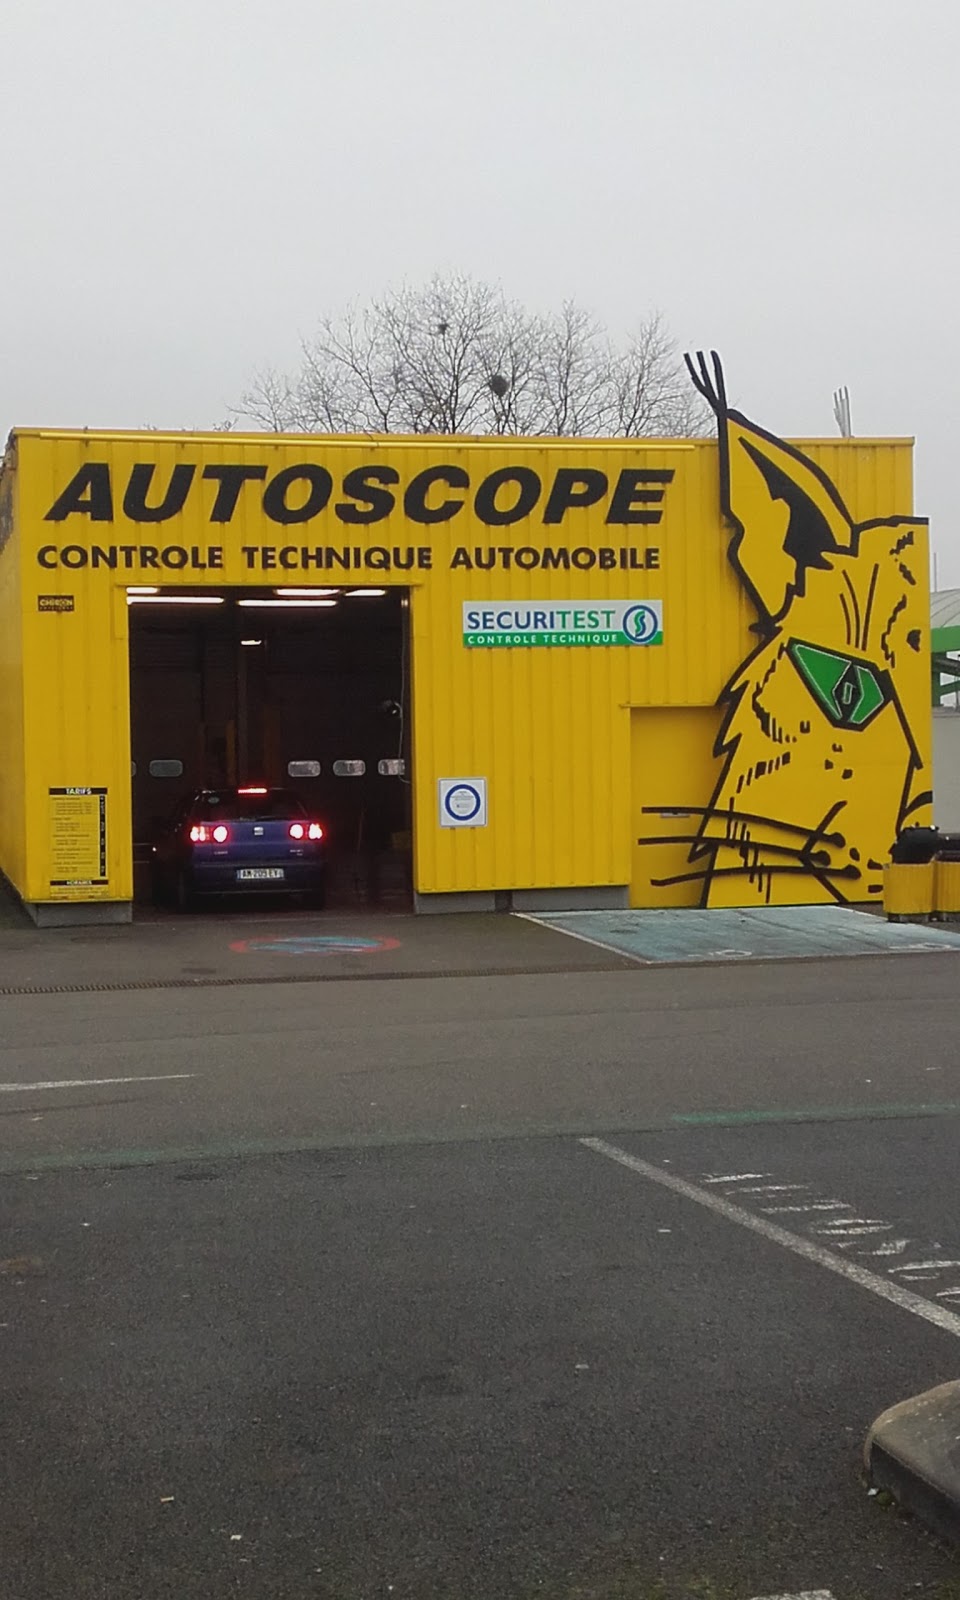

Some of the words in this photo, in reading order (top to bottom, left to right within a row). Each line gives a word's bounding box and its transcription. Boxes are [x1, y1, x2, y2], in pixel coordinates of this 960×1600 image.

[43, 462, 675, 526] AUTOSCOPE
[37, 545, 223, 569] CONTROLE
[242, 546, 433, 570] TECHNIQUE
[450, 546, 660, 570] AUTOMOBILE
[467, 610, 616, 630] SECURITEST
[467, 634, 537, 645] CONTROLE
[543, 633, 618, 644] TECHNIQUE
